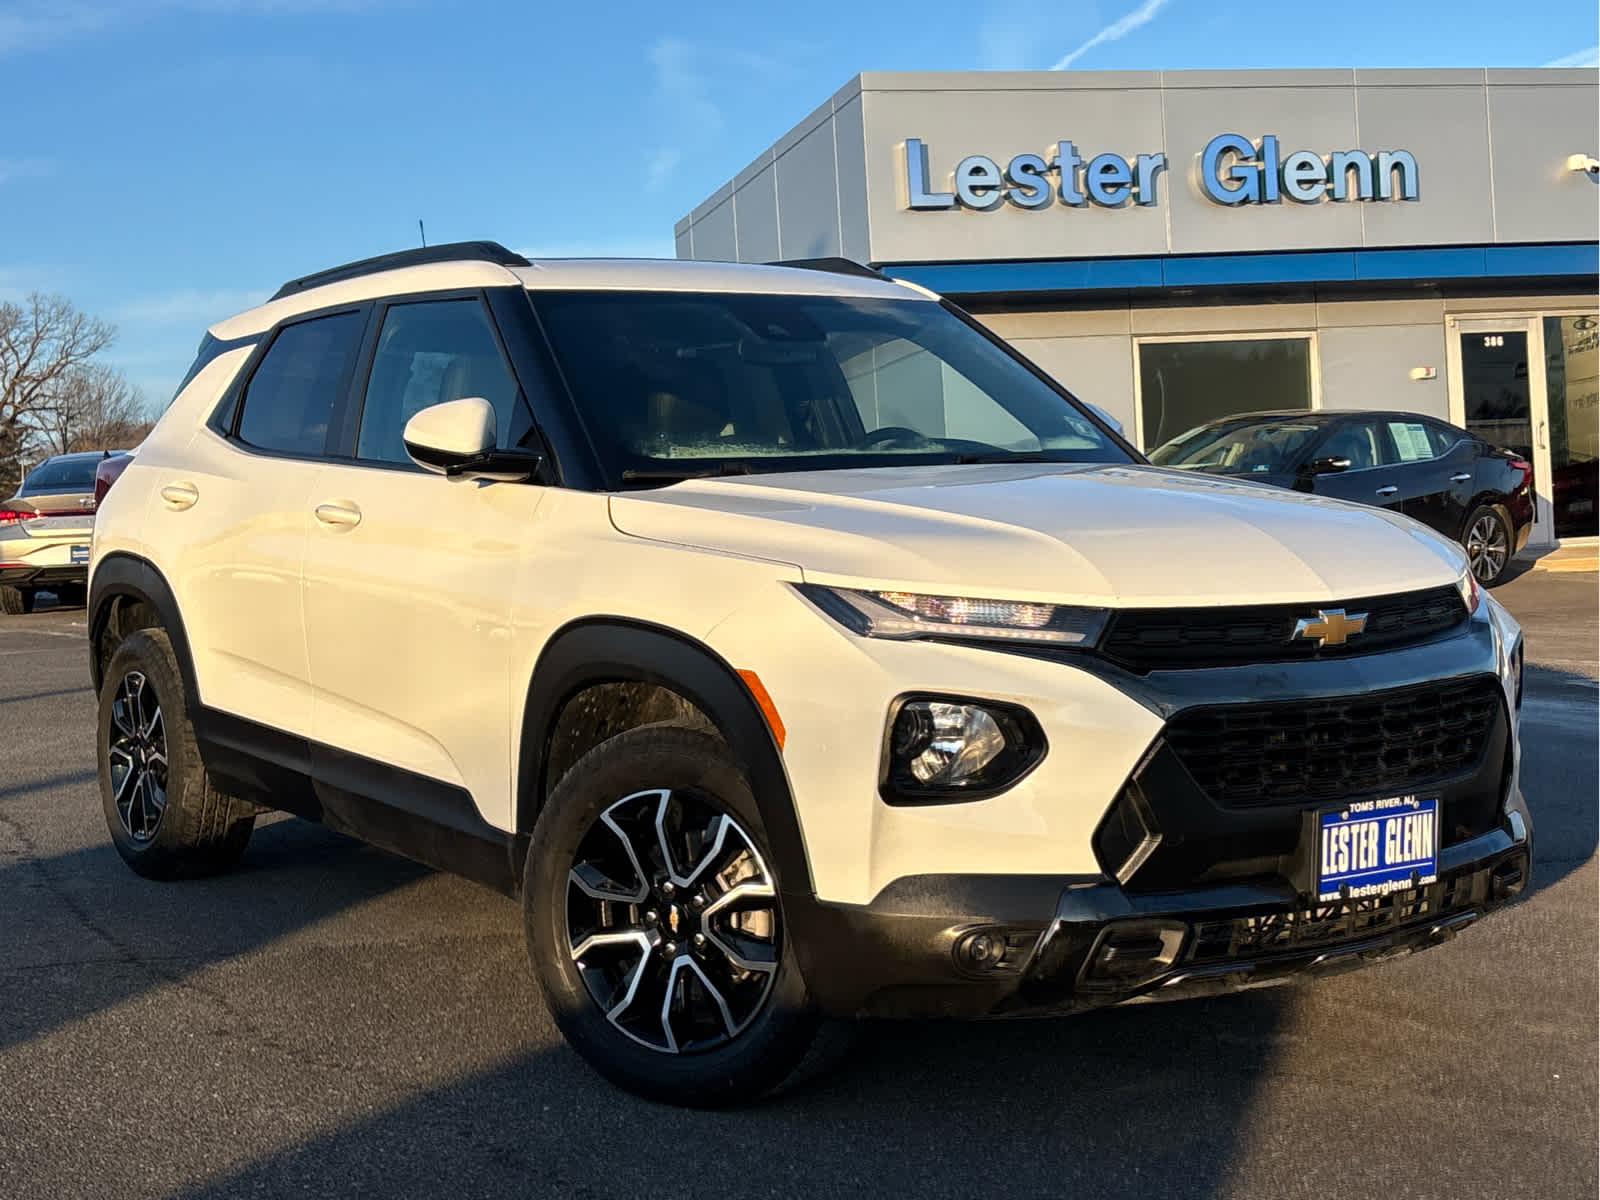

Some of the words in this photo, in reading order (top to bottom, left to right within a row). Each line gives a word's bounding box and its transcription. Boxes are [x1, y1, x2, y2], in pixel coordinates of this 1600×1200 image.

[902, 137, 1167, 210] Lester
[1200, 132, 1417, 205] Glenn
[1350, 801, 1375, 813] TOMS
[1404, 795, 1415, 806] NJ
[1321, 821, 1379, 876] LESTER
[1385, 813, 1433, 866] GLENN
